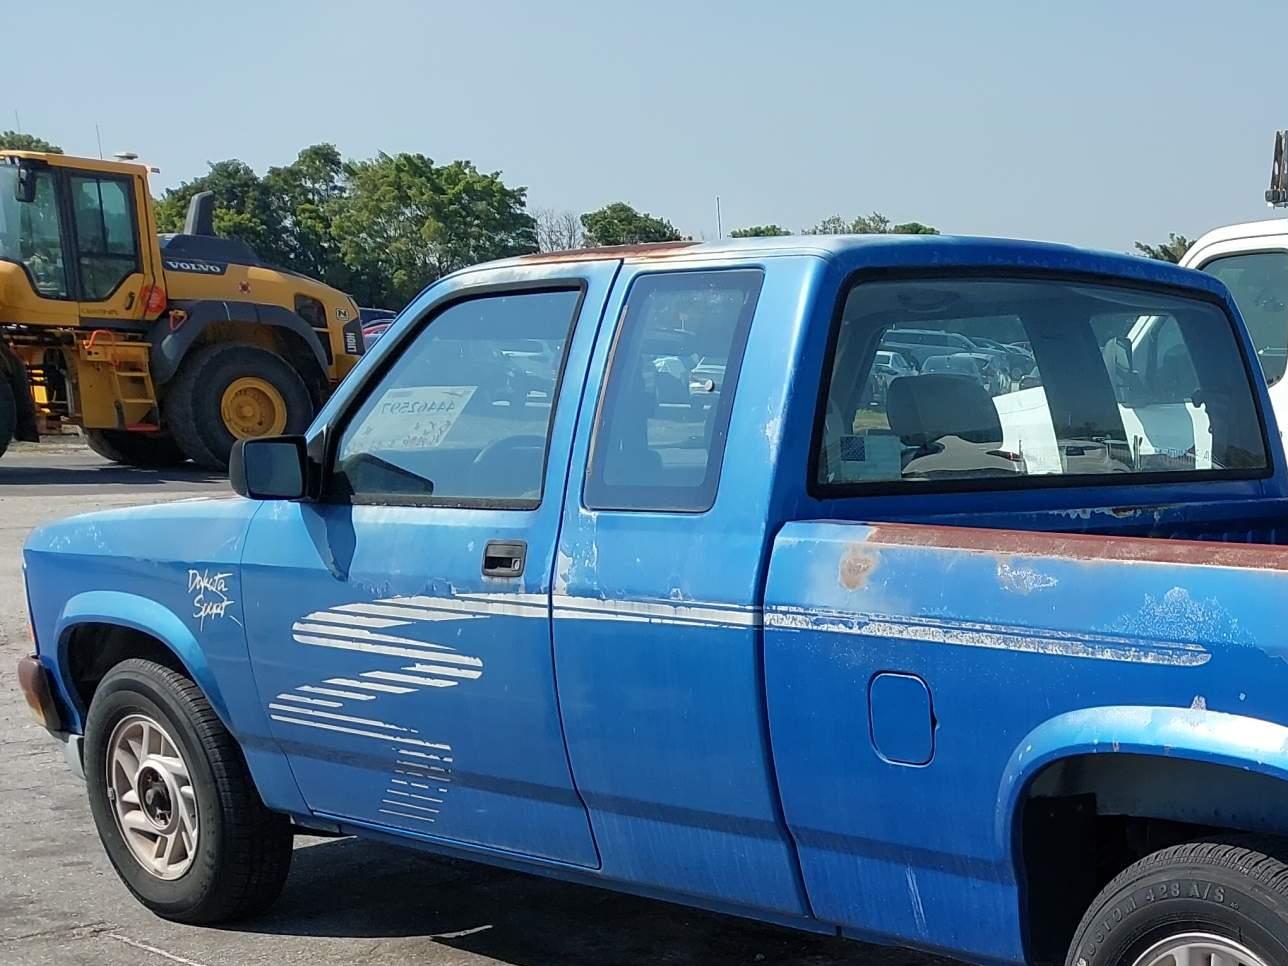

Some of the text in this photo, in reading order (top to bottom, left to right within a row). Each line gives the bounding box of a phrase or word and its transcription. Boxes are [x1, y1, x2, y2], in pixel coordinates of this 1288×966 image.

[166, 260, 221, 273] VOLVO
[188, 568, 233, 593] Dakota
[1146, 882, 1181, 902] 428
[1189, 881, 1226, 904] A/S
